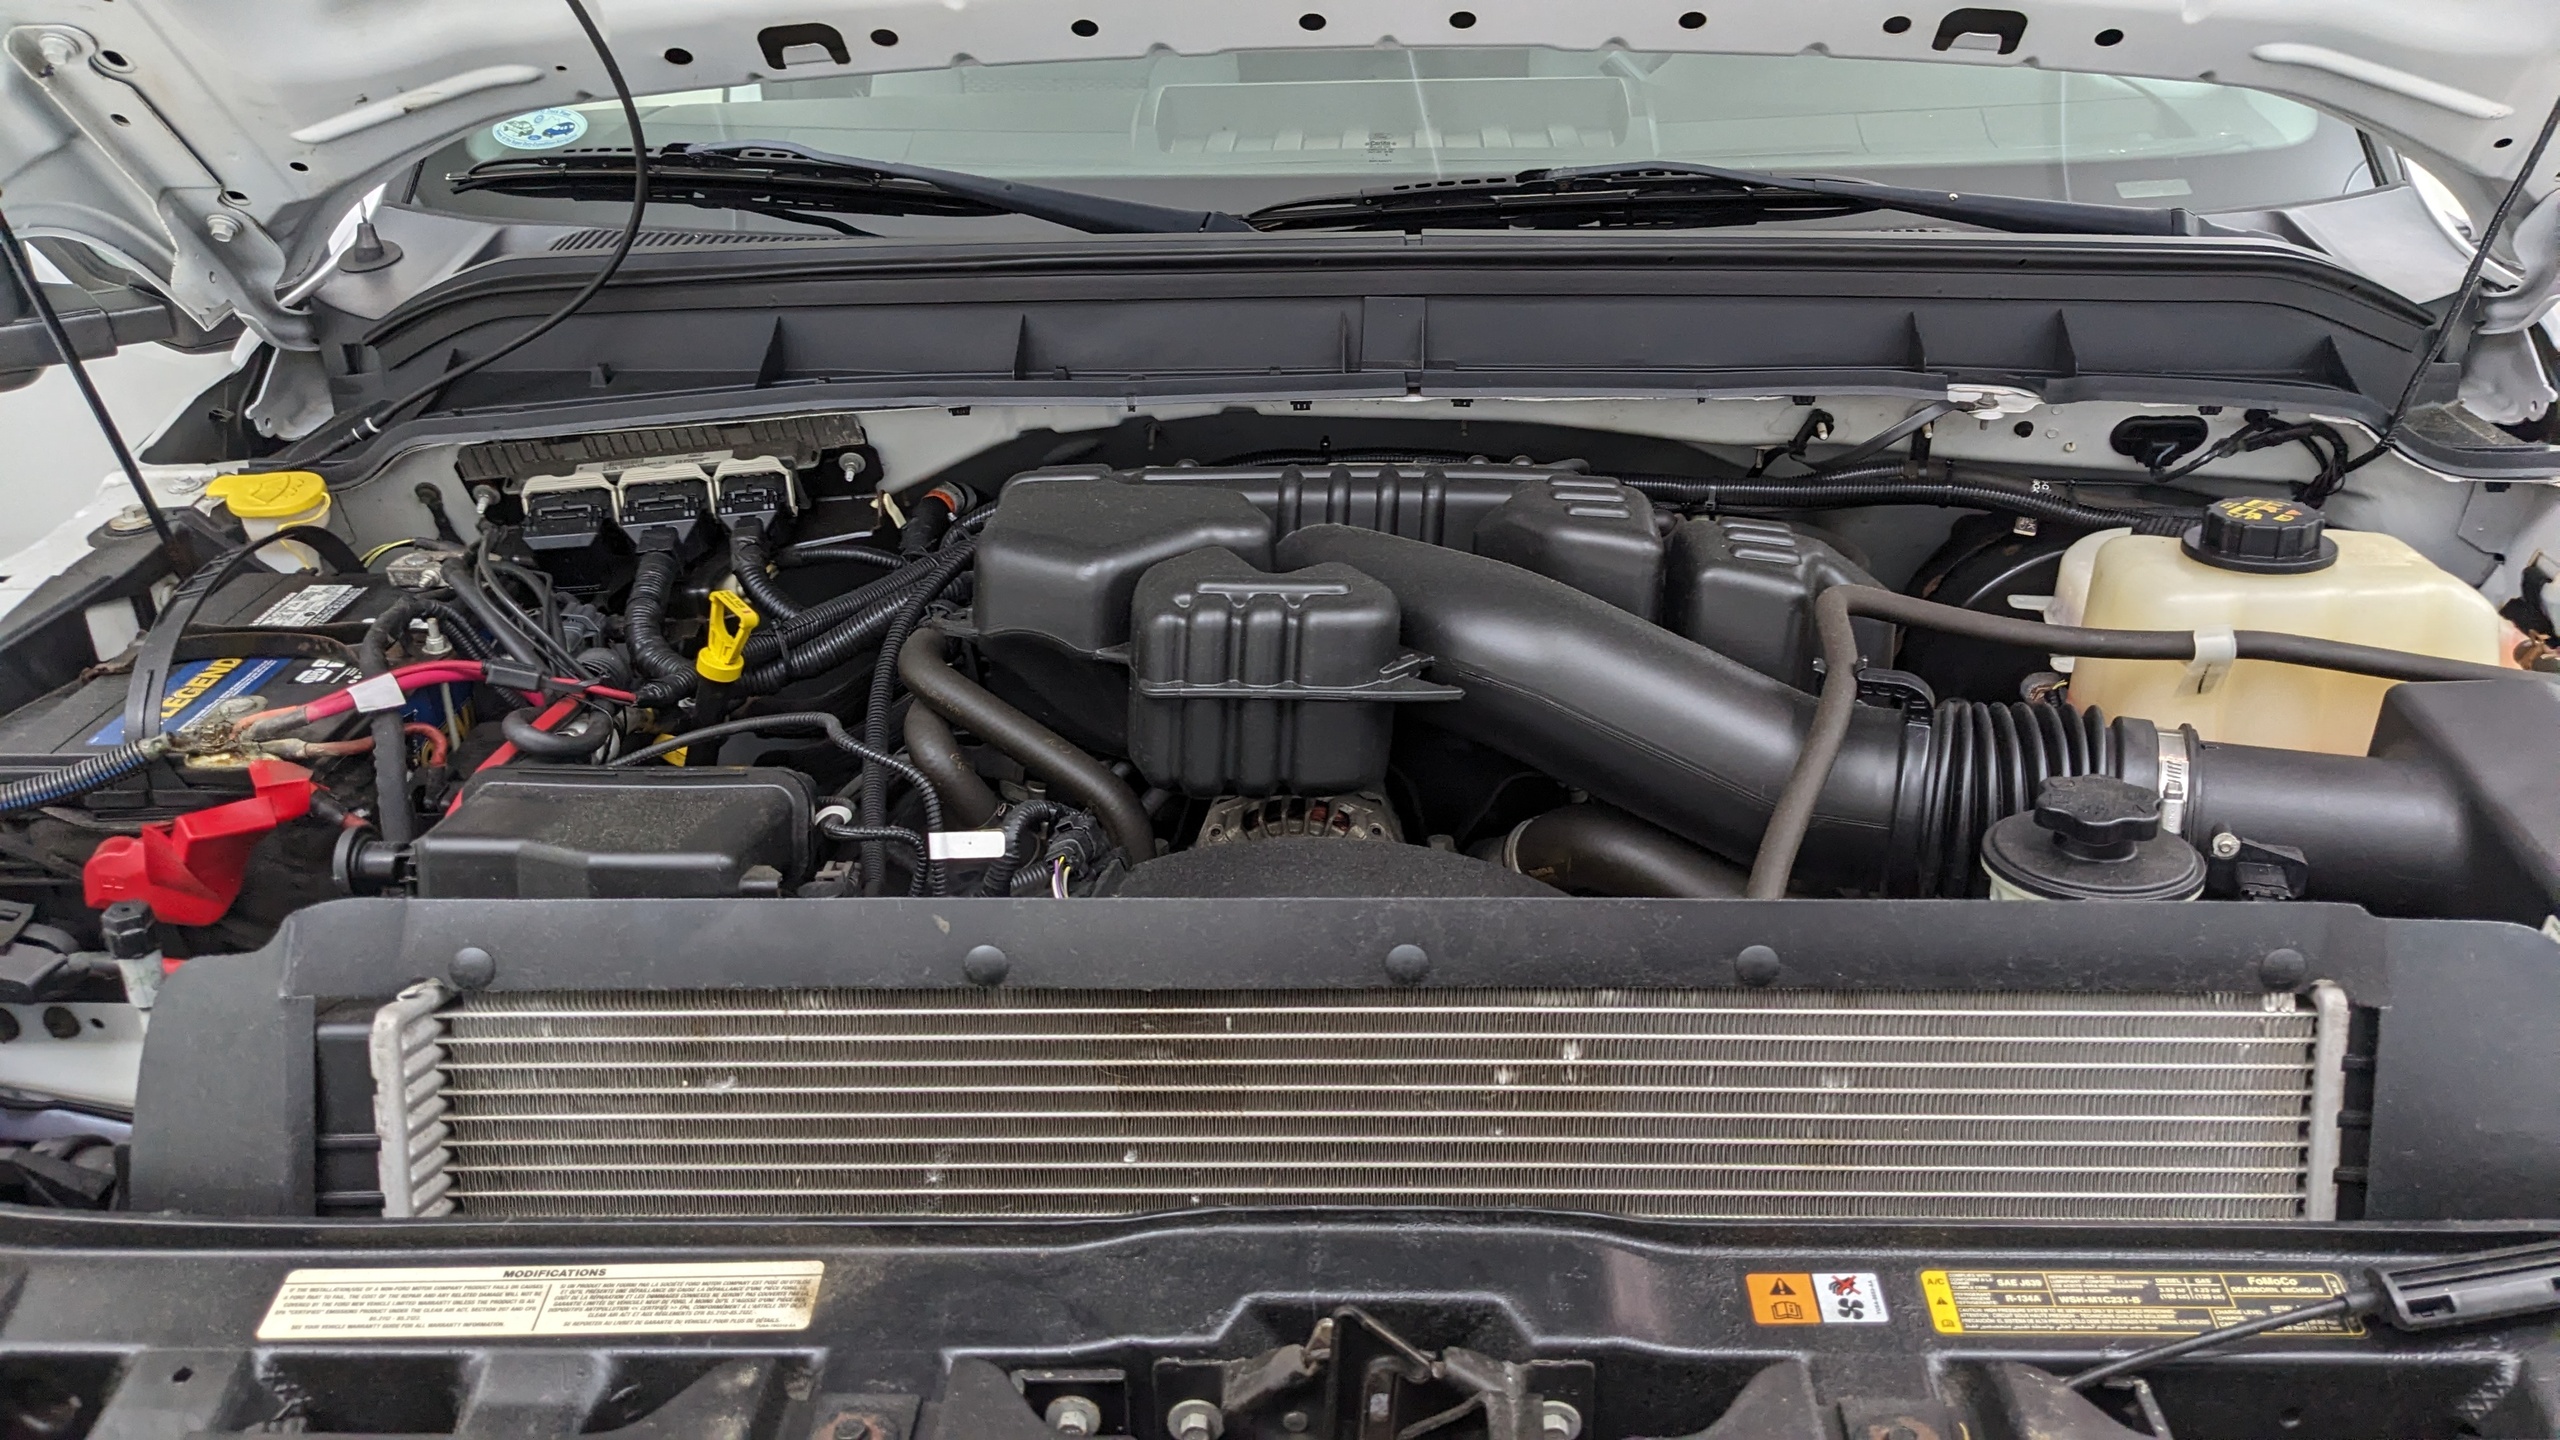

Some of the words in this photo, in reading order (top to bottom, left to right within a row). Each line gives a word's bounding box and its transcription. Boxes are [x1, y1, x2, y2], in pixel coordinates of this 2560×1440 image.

[161, 658, 243, 718] LEGEND
[502, 1269, 606, 1278] MODIFICATIONS
[2246, 1276, 2298, 1284] FoMoCo
